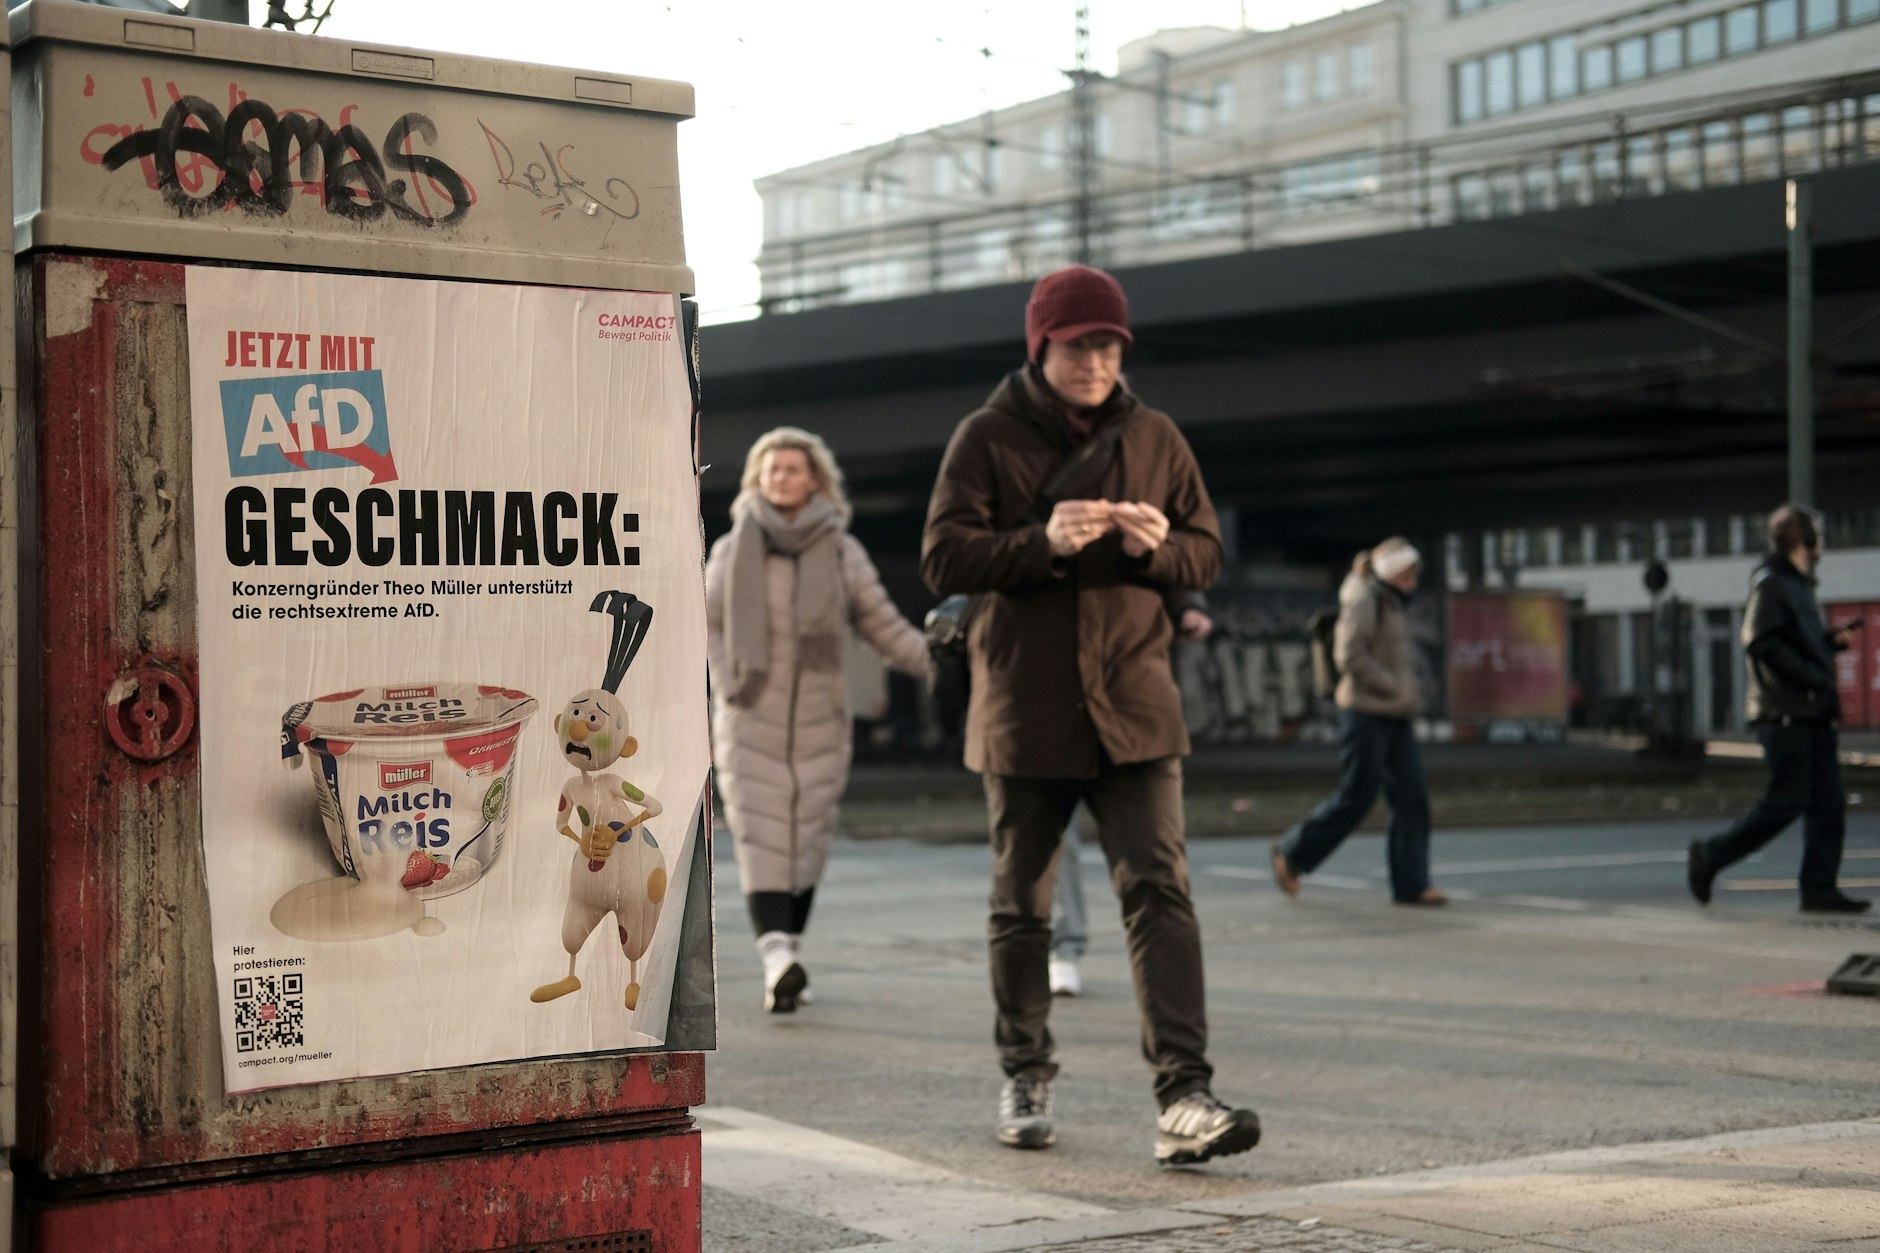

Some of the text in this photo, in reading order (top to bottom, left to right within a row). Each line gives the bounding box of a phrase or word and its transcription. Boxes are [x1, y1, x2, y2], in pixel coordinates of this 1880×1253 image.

[598, 329, 672, 342] Bewegt Politik
[225, 331, 375, 371] JETZT MIT
[239, 383, 374, 457] AfD
[224, 485, 641, 567] GESCHMACK:
[232, 580, 573, 600] Konzerngründer Theo Müller unterstützt
[232, 603, 440, 619] die rechtsextreme AfD.
[356, 699, 463, 712] Milch
[353, 709, 467, 724] Reis
[385, 768, 427, 783] müller
[357, 788, 452, 820] Milch
[358, 812, 450, 855] Reis
[233, 946, 255, 956] Hier
[233, 957, 306, 973] protestieren:
